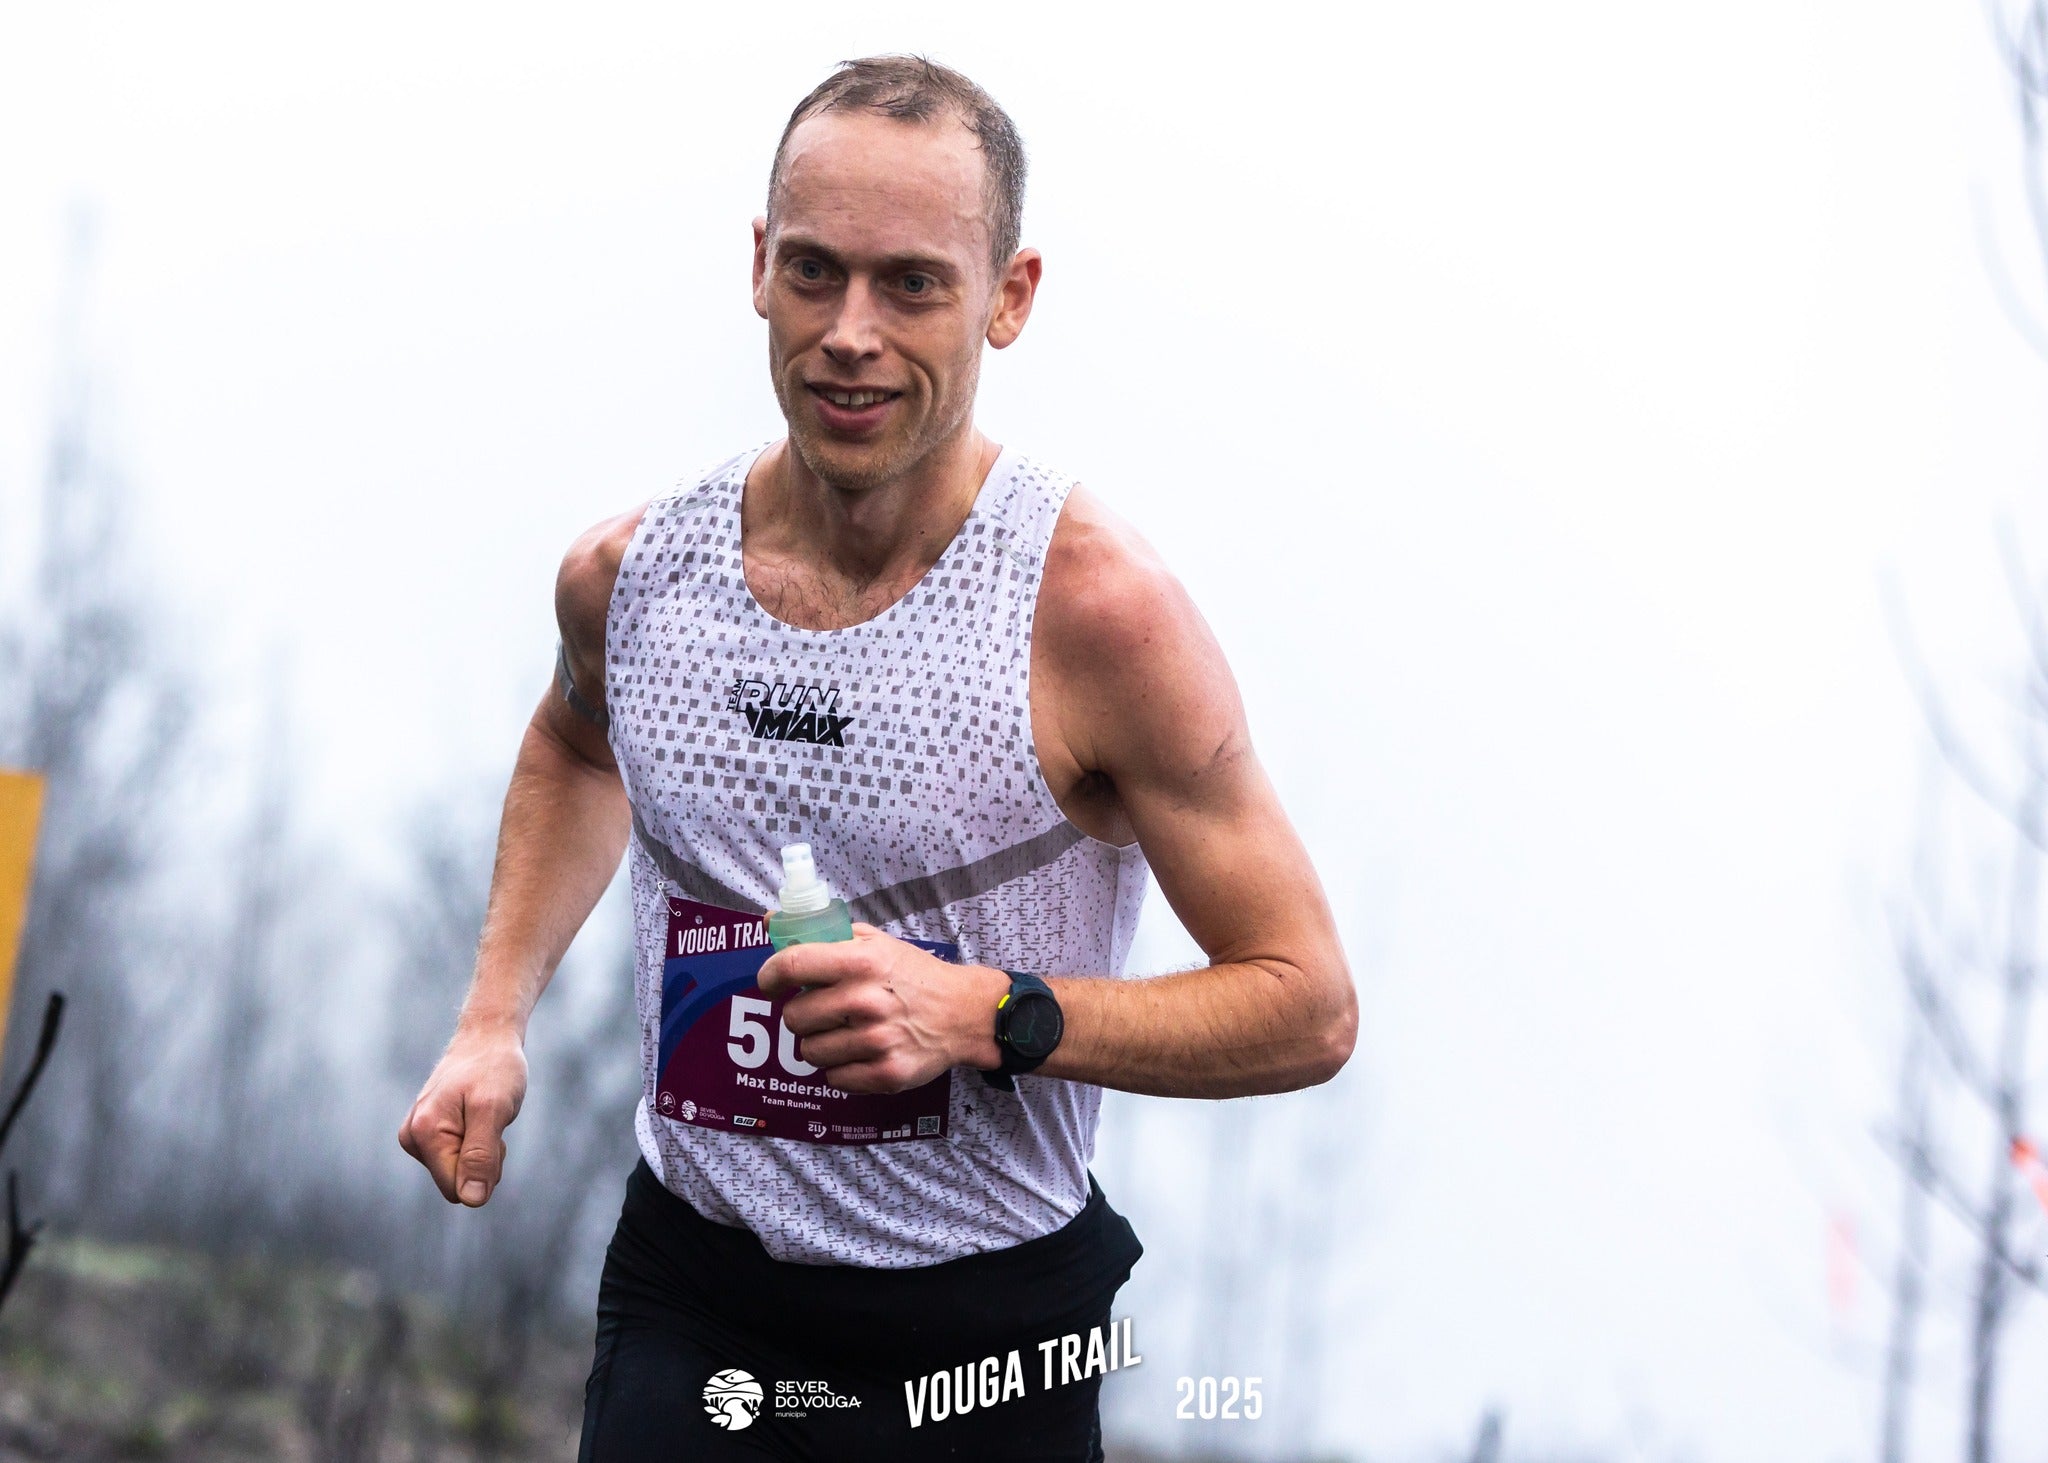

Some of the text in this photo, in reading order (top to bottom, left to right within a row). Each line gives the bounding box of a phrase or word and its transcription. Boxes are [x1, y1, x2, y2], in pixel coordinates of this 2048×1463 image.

[726, 679, 744, 712] TEAM
[735, 680, 840, 714] RUN
[752, 708, 855, 748] MAX
[678, 920, 773, 955] VOUGA TRA
[736, 1072, 849, 1100] Max Boderskov
[762, 1096, 822, 1111] Team RunMax
[808, 1123, 823, 1133] 112
